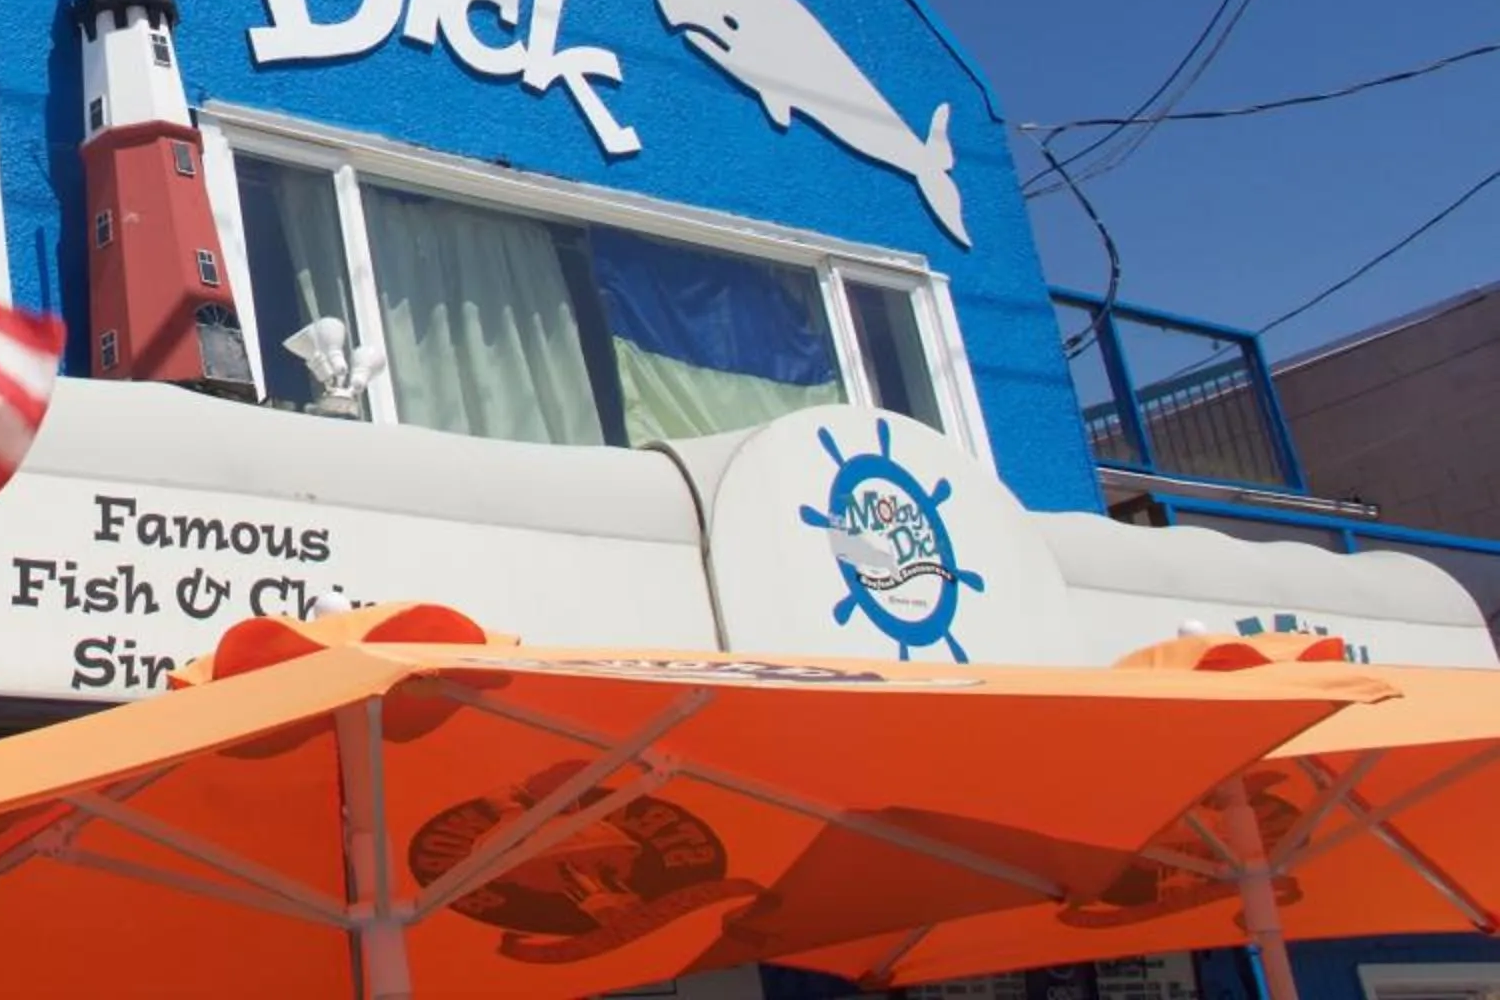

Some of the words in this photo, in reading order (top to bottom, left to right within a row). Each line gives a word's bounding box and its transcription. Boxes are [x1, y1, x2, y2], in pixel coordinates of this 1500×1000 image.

[93, 494, 332, 564] Famous
[887, 524, 941, 566] Dic
[11, 556, 160, 615] Fish
[175, 566, 231, 620] &
